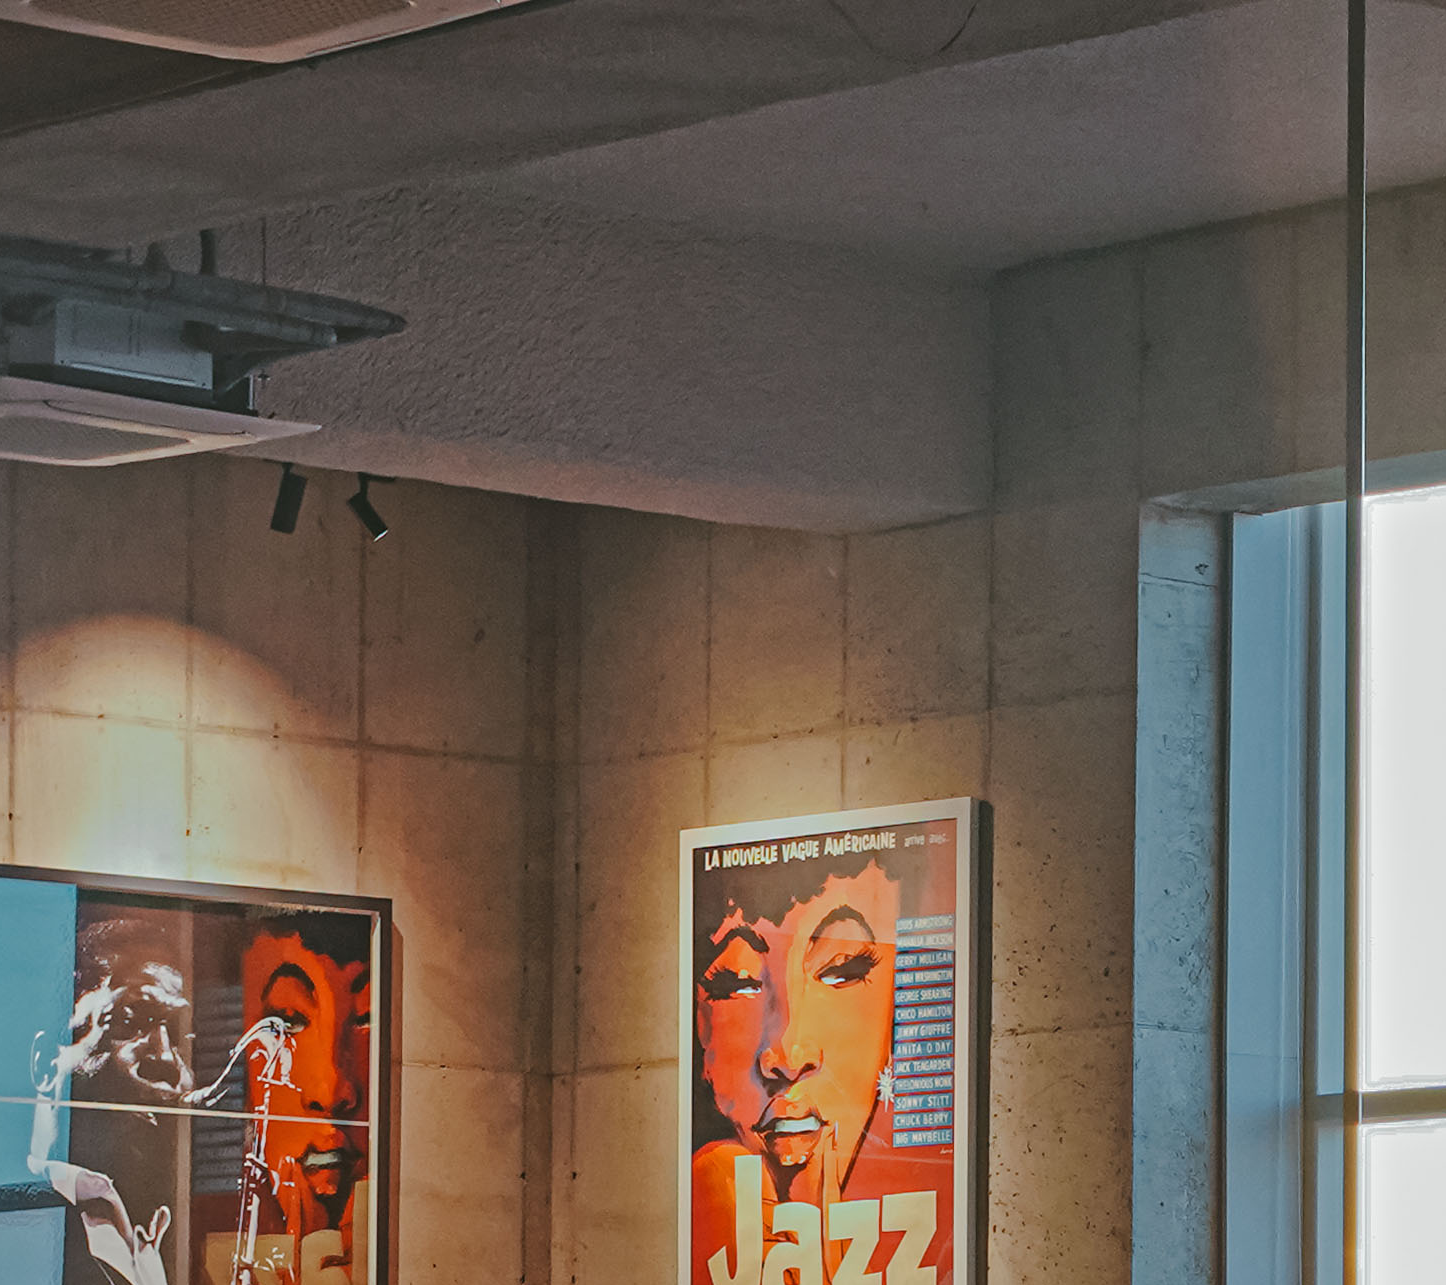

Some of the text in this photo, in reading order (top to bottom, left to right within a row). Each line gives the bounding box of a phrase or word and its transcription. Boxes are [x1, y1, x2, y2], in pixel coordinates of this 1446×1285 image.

[704, 848, 719, 871] LA
[723, 845, 778, 868] NOUVELLE
[781, 840, 819, 863] VAGUE
[823, 831, 896, 856] AMÉRICAINE
[896, 950, 952, 967] GERRY MULLIGAN
[896, 986, 952, 1003] GEORGE SHEARING
[896, 1005, 952, 1020] CHICO HAMILTON
[896, 1023, 951, 1039] JIMMY GIUFFRE
[896, 1042, 922, 1055] ANITA
[895, 1057, 952, 1073] JACK TEAGARDEN
[935, 1075, 953, 1088] MONK
[896, 1094, 949, 1109] SONNY STITT
[895, 1112, 949, 1127] CHUCK BERRY
[895, 1130, 952, 1145] BIG MAYBELLE
